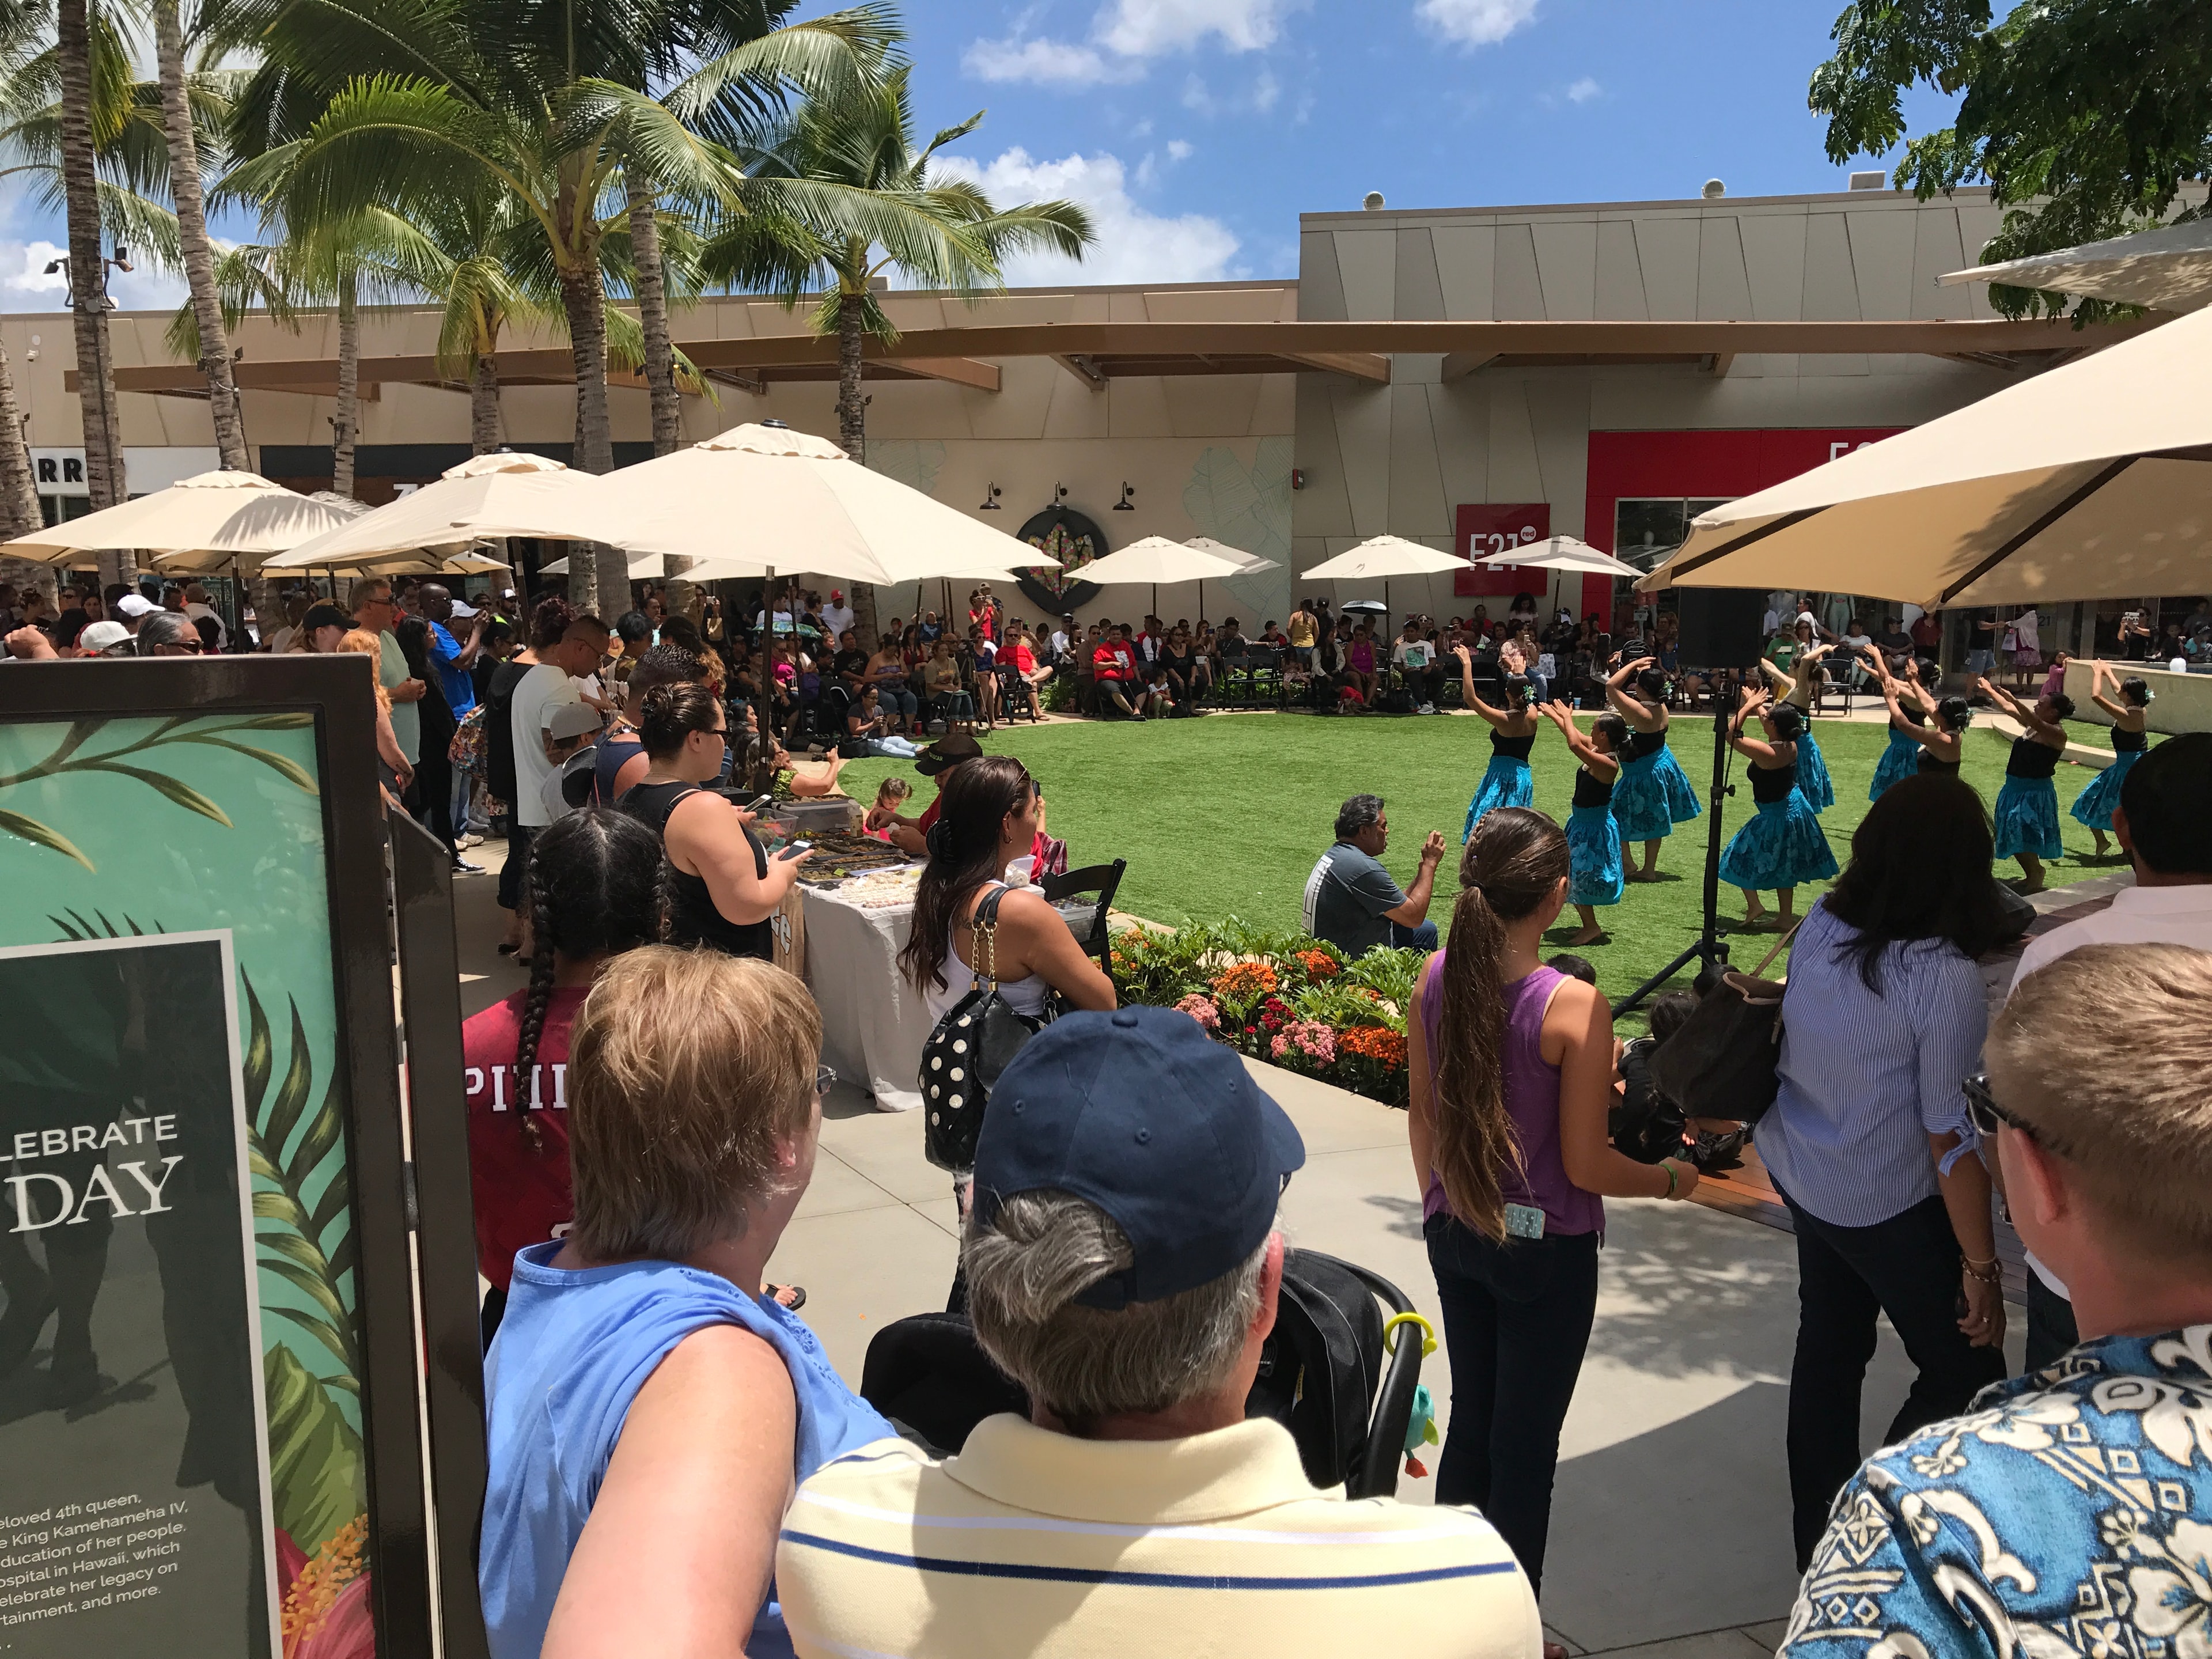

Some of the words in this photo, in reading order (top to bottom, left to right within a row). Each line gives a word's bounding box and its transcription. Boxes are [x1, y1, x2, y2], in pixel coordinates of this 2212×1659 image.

[38, 458, 83, 482] RR
[1469, 533, 1518, 571] F21
[3, 1156, 184, 1233] DAY
[55, 1503, 82, 1520] 4th
[86, 1494, 142, 1514] queen,
[1, 1546, 71, 1568] ducation
[76, 1538, 92, 1553] of
[96, 1535, 123, 1550] her
[127, 1522, 186, 1546] people.
[12, 1531, 48, 1547] King
[53, 1507, 165, 1539] Kamehameha
[54, 1565, 68, 1577] in
[73, 1552, 129, 1574] Hawaii,
[132, 1541, 180, 1560] which
[70, 1578, 96, 1593] her
[100, 1567, 154, 1587] legacy
[157, 1562, 178, 1574] on
[0, 1601, 78, 1626] tainment,
[81, 1593, 112, 1610] and
[116, 1586, 161, 1603] more.
